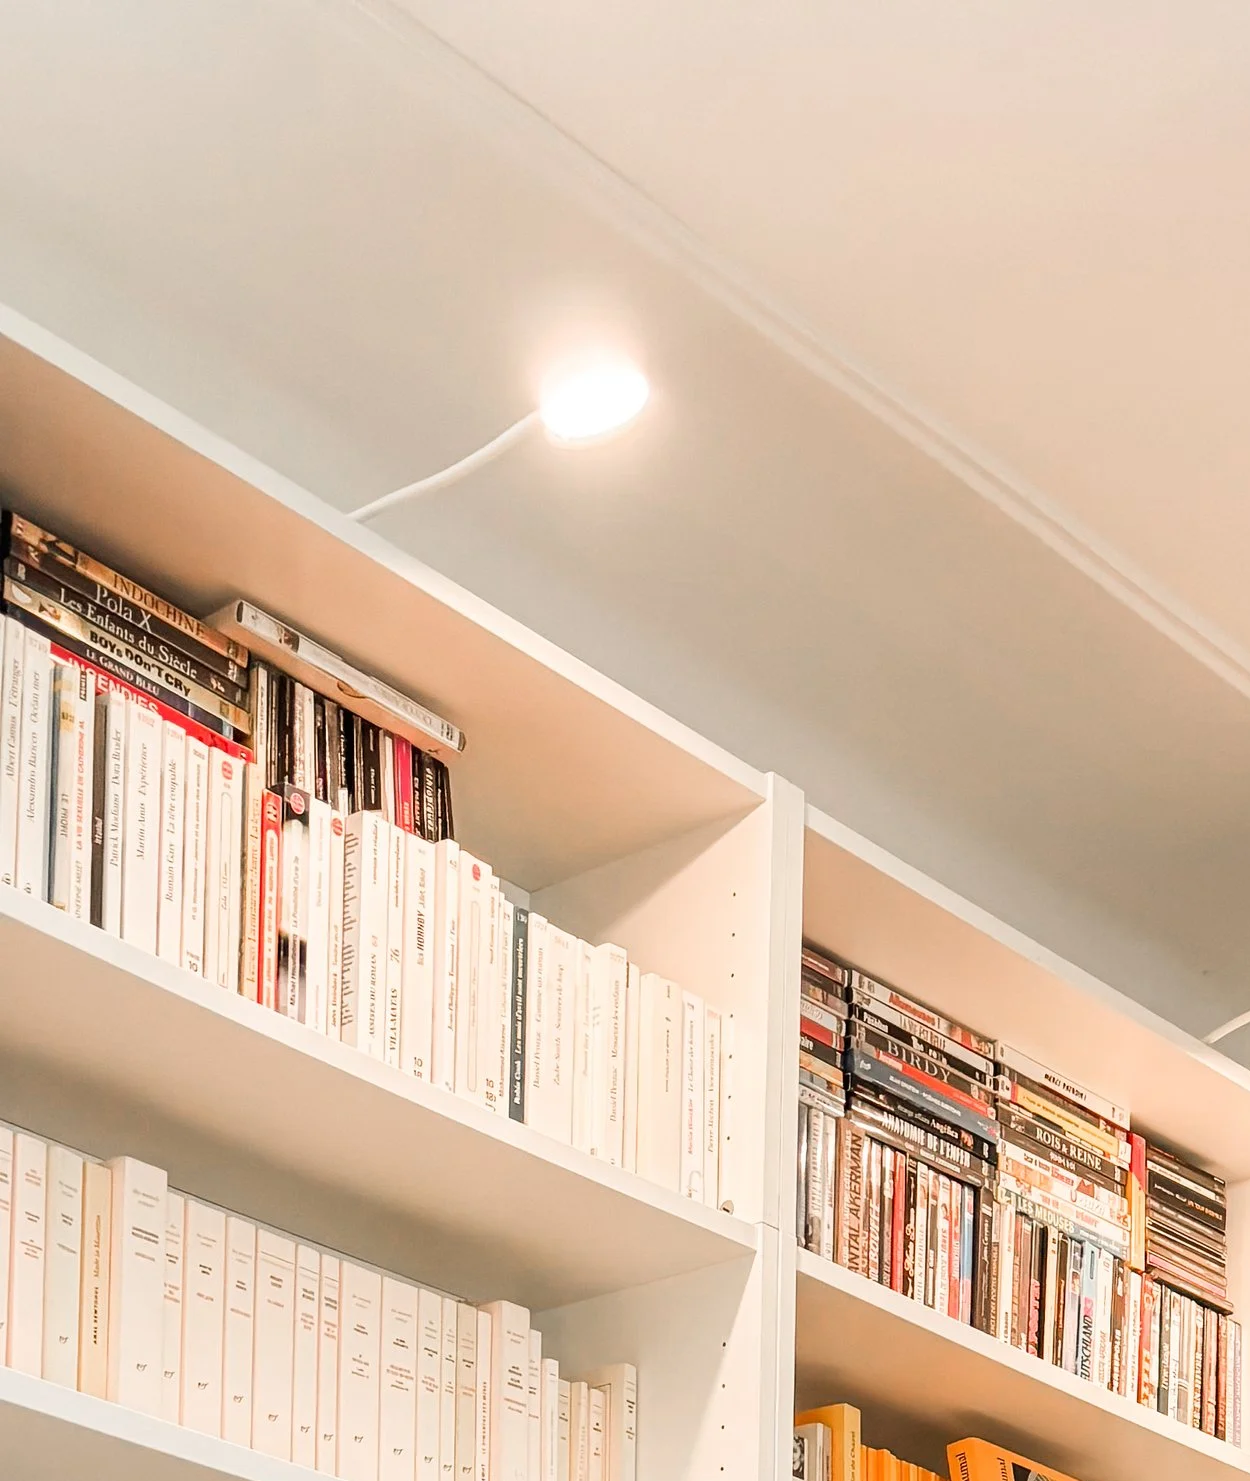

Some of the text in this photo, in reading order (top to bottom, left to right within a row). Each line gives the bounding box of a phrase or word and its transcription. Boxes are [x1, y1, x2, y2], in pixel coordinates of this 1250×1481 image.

[96, 584, 154, 633] Pola X
[113, 574, 207, 639] INDOCHINE
[60, 588, 198, 679] Les Enfants du Siècle
[86, 650, 160, 697] LE GRAND BLEU
[7, 716, 17, 749] Camus
[111, 764, 120, 785] Dora
[111, 794, 120, 833] Modiano
[136, 743, 148, 860] Martin Amis Expérience
[109, 835, 118, 867] Patrick
[886, 1040, 952, 1082] BIRDY
[1036, 1127, 1061, 1149] ROIS
[1070, 1143, 1102, 1171] REINE
[848, 1133, 861, 1220] AKERMAN
[1080, 1315, 1094, 1379] EUTSCHLAND
